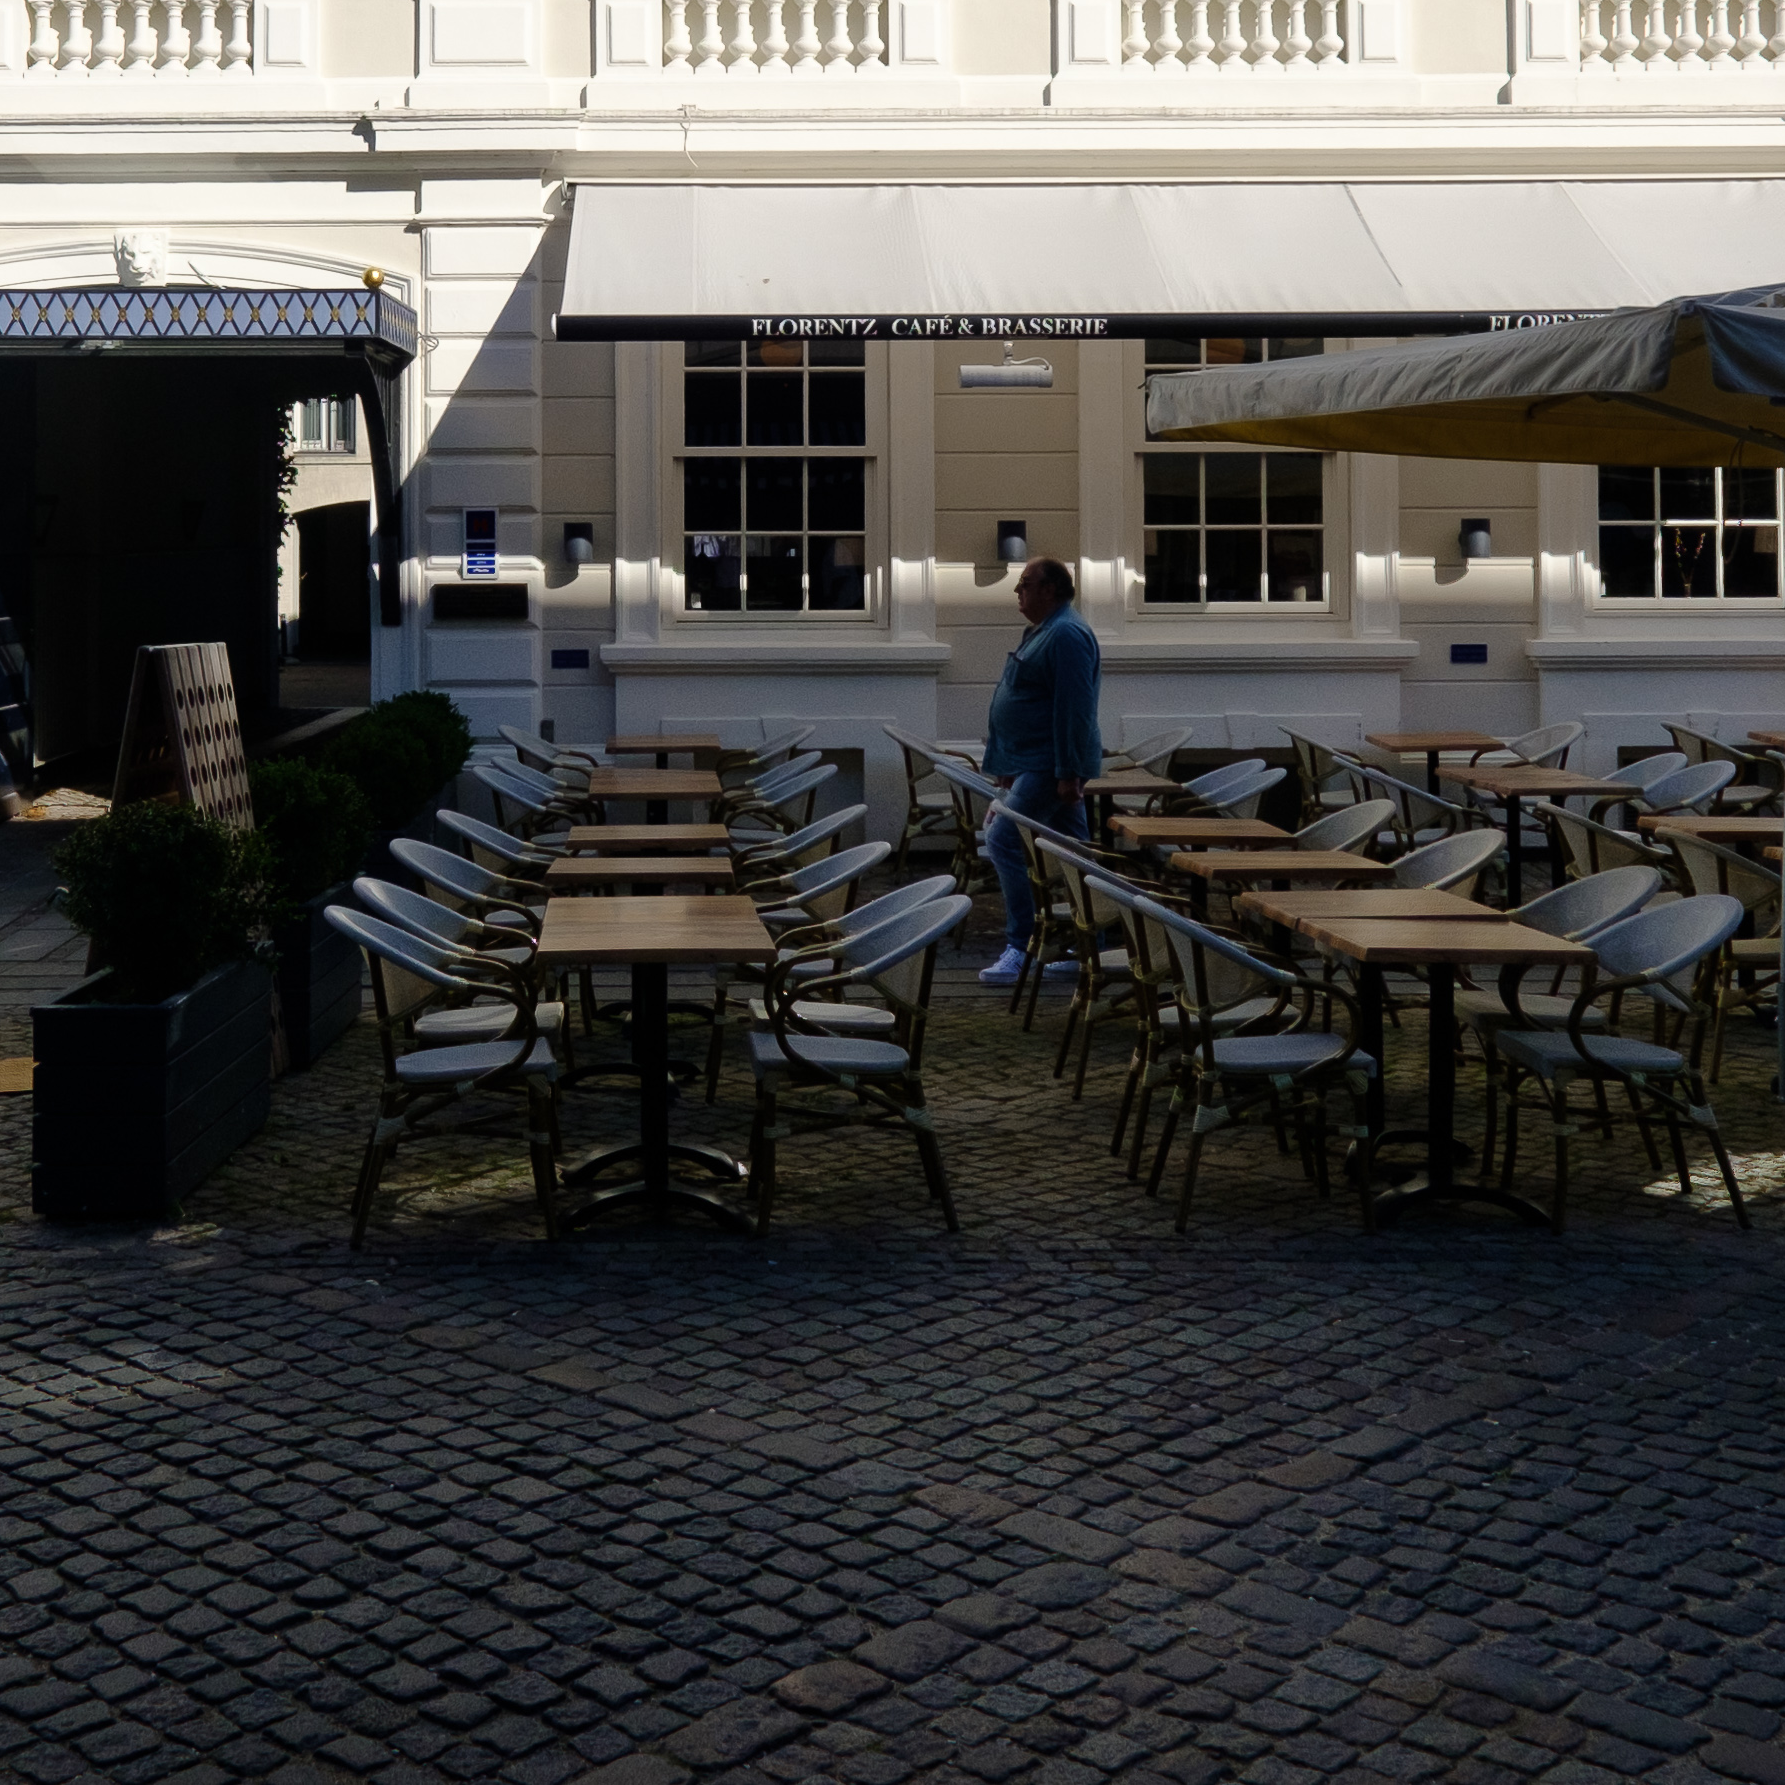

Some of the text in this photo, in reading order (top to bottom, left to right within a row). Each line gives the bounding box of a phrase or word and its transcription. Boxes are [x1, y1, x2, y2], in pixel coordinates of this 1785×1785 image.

[751, 314, 1109, 337] FLORENTZ CAFÉ & BRASSERIE
